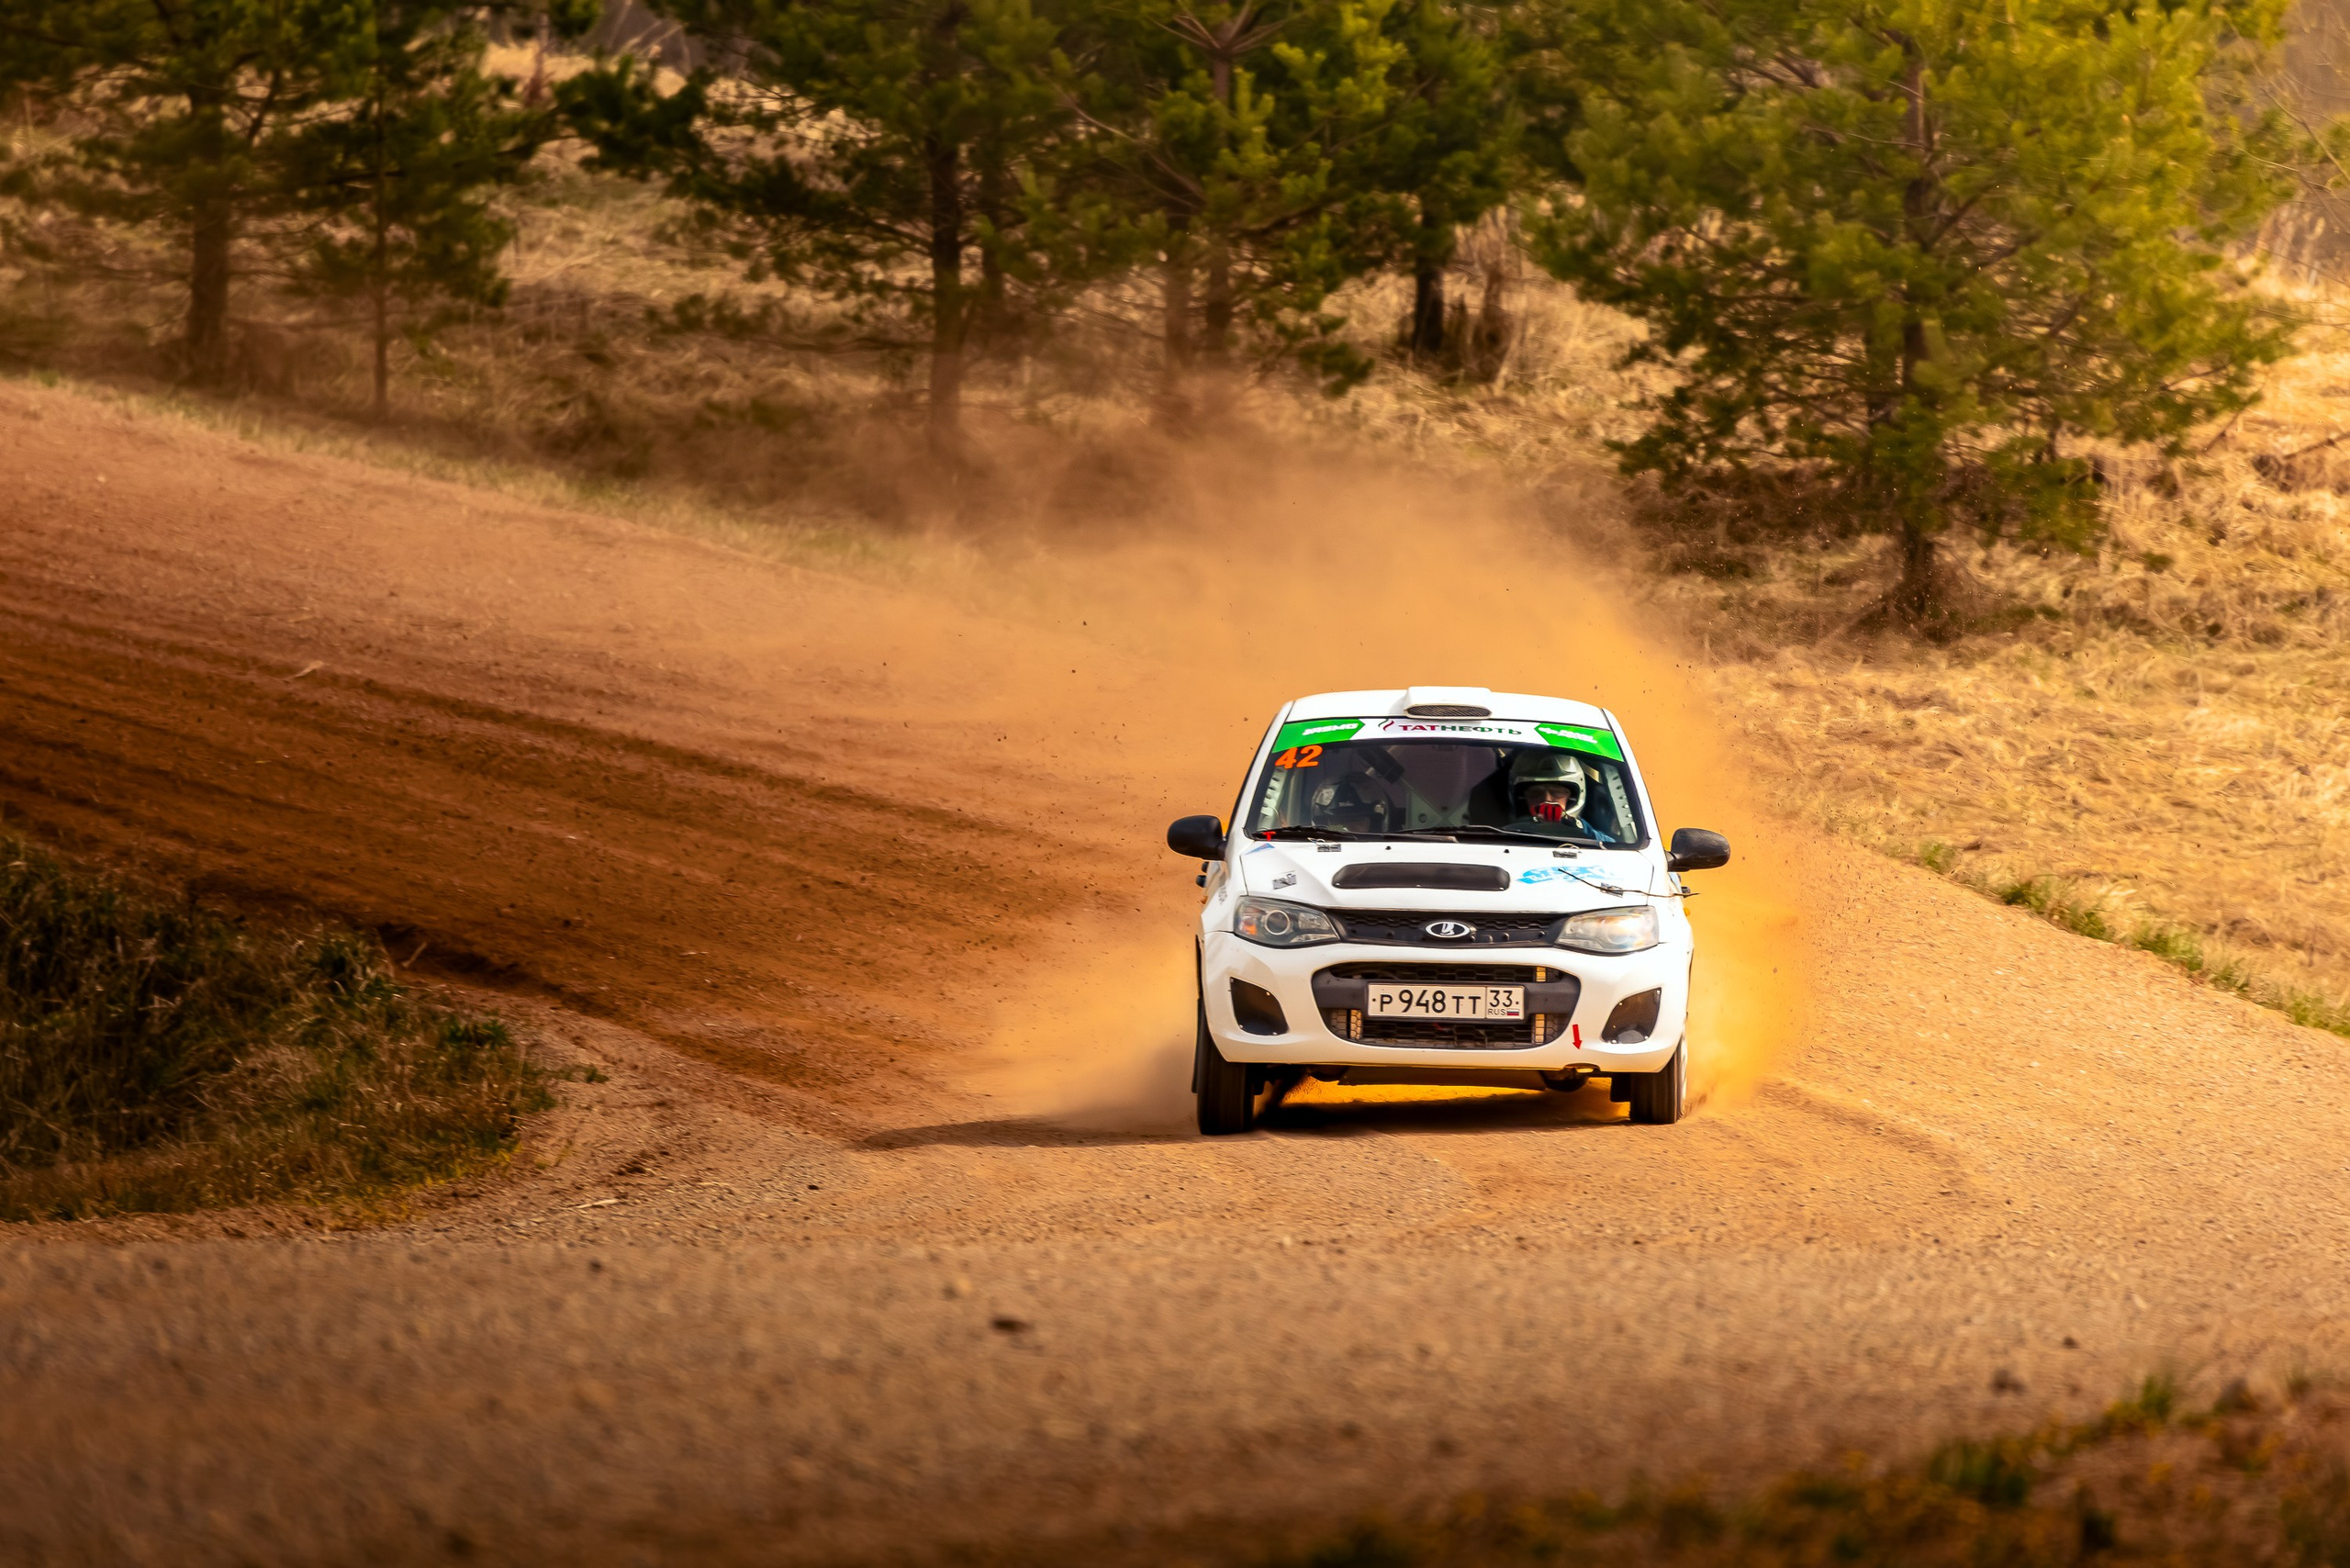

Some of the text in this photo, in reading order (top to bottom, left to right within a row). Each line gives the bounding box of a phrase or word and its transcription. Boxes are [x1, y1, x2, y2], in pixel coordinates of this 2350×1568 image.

[1274, 745, 1324, 769] 42
[1489, 990, 1514, 1008] 33
[1487, 1008, 1506, 1016] RUS
